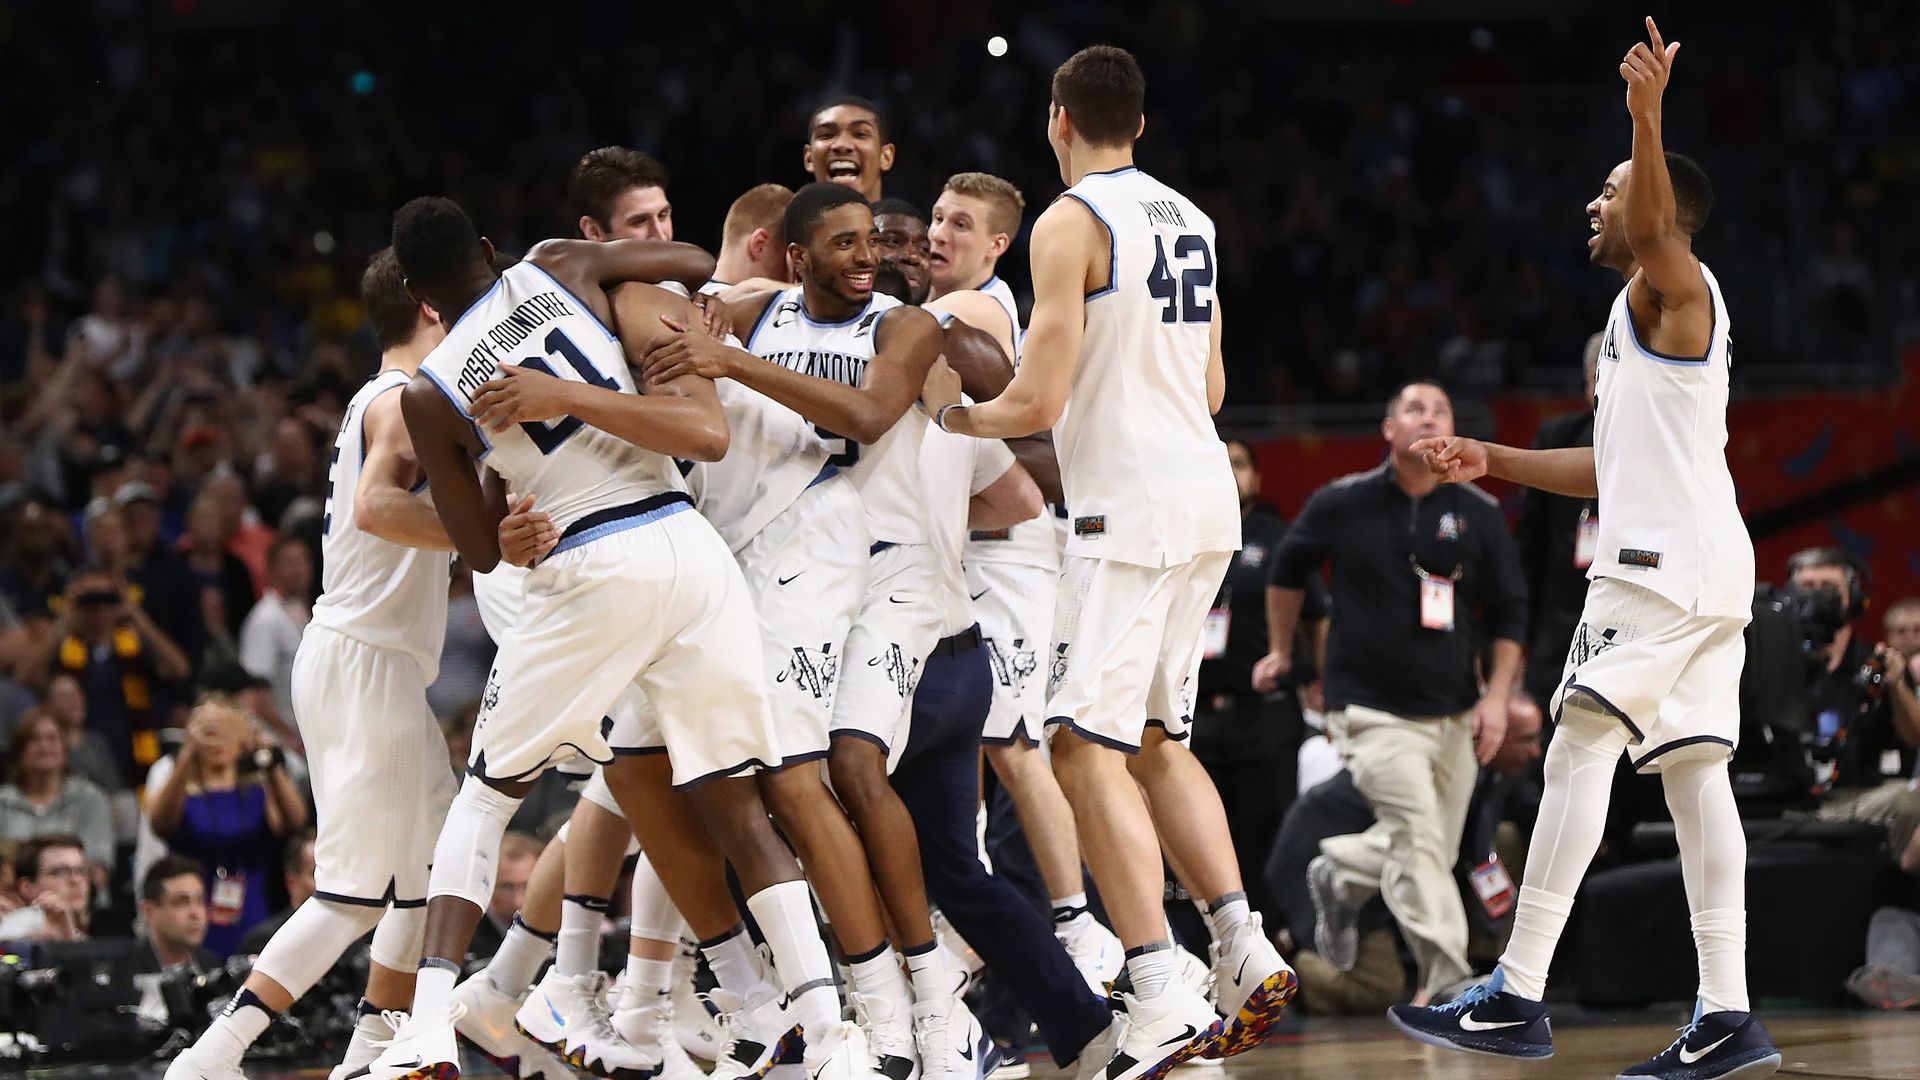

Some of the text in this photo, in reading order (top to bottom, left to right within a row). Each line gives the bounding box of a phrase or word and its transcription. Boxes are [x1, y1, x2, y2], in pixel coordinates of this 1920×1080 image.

[1147, 234, 1213, 322] 42
[457, 291, 574, 404] COSBY-ROUNDTREE
[761, 350, 869, 388] LLANOV
